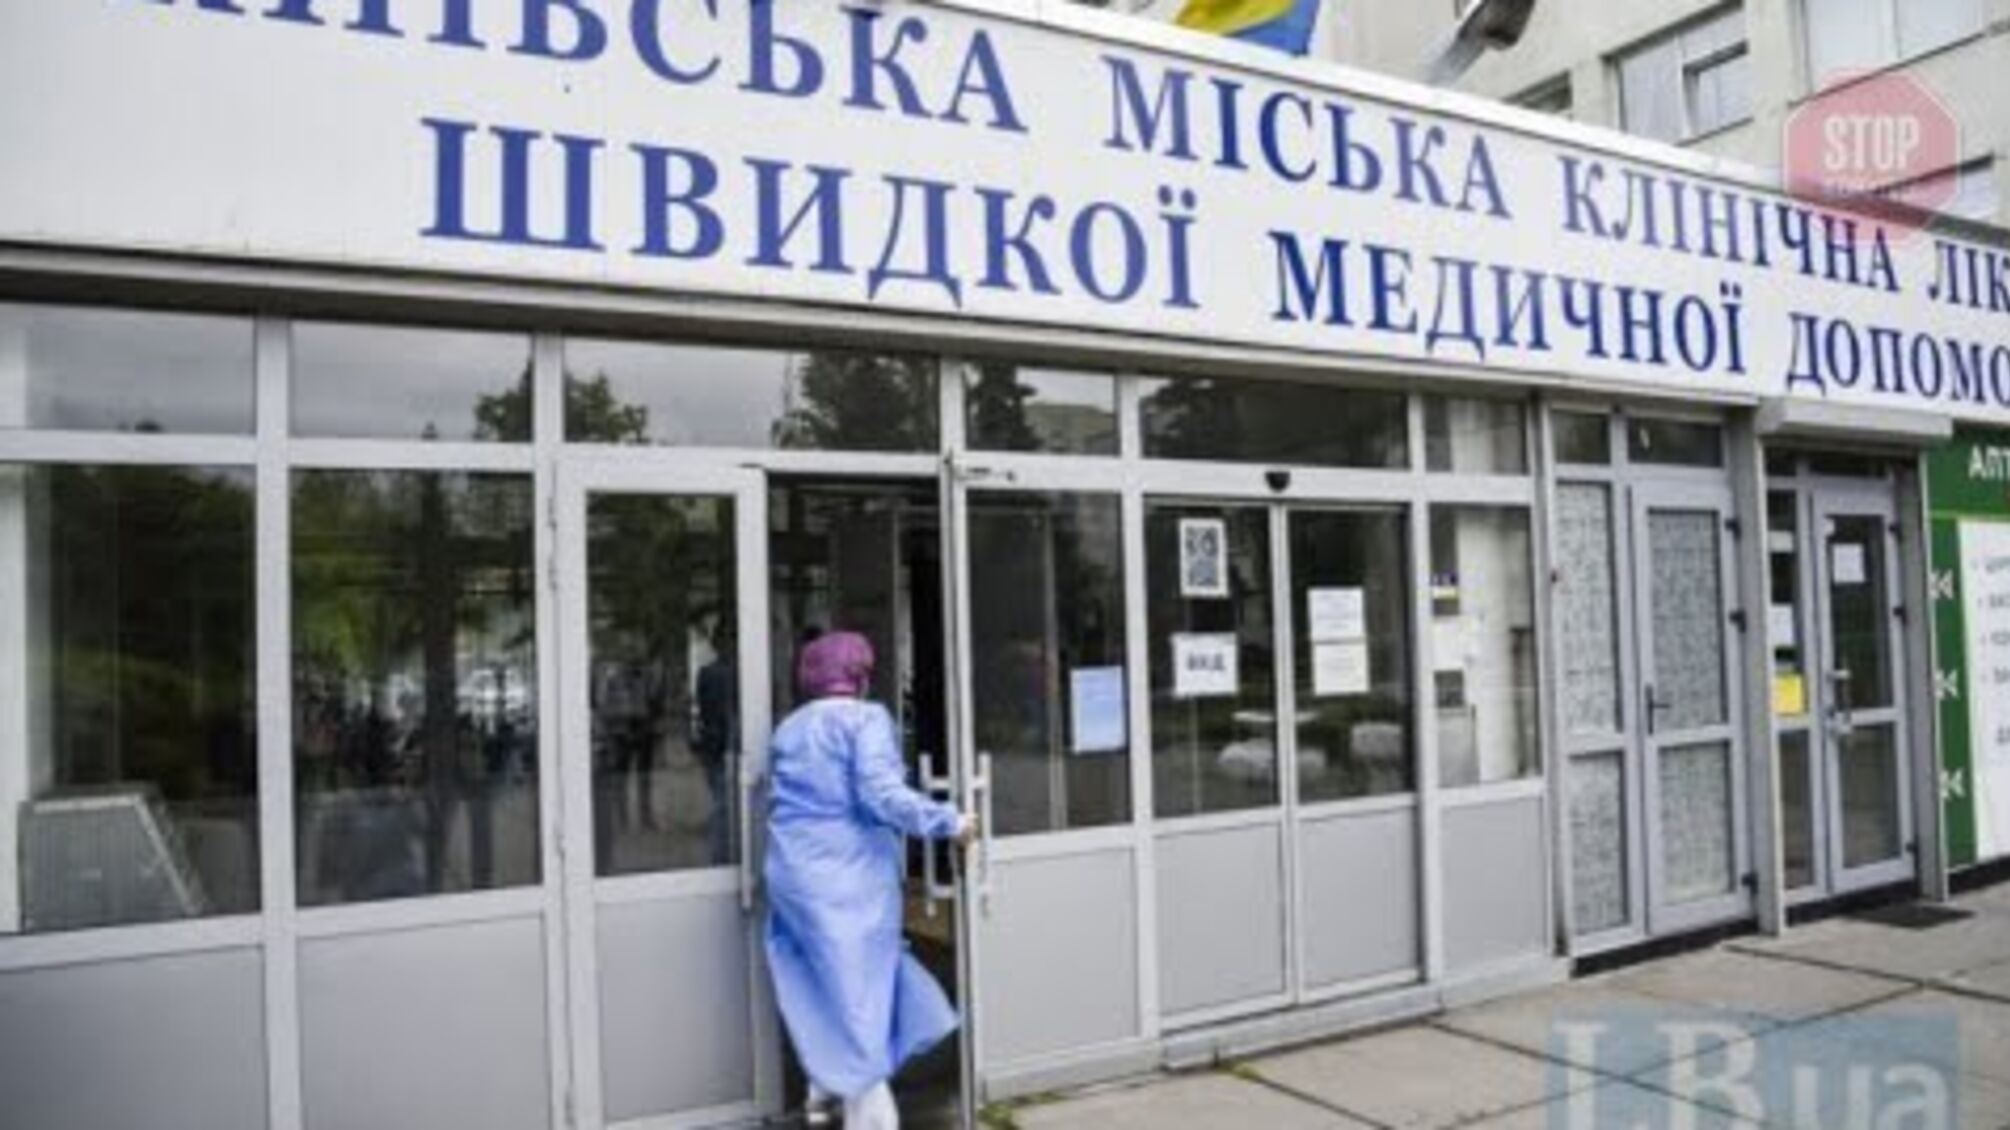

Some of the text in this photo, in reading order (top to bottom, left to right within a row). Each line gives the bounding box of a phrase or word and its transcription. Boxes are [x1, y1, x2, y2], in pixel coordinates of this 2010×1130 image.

[420, 117, 2010, 408] ШВИДКОЇ МЕДИЧНОЇ ДОПОМО
[1101, 54, 1511, 221] МІСЬКА
[1559, 156, 1900, 293] КЛІНІЧНА
